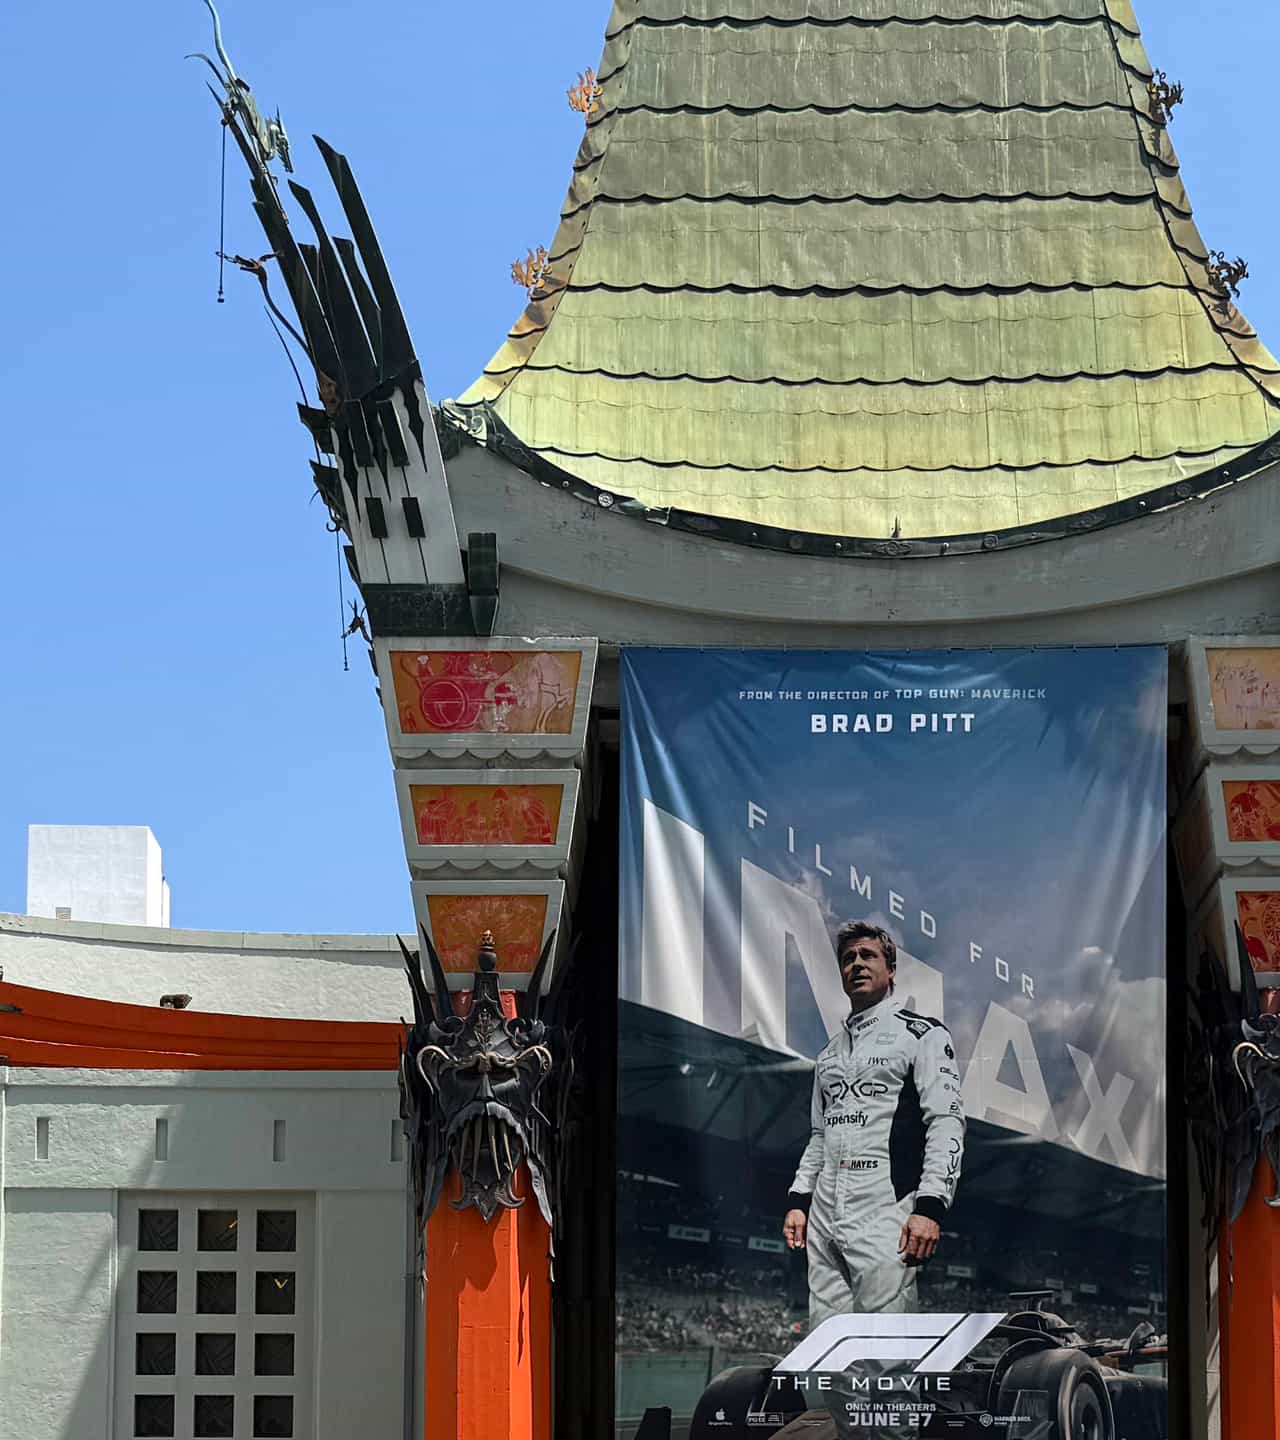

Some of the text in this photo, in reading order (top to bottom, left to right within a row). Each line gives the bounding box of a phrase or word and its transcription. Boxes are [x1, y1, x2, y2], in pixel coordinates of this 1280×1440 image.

[738, 687, 1047, 700] FROM THE DIRECTOR OF TOP GUN: MAVERICK
[810, 712, 976, 733] BRAD PITT
[747, 800, 1035, 999] FILMED FOR
[850, 1159, 879, 1169] HAYES
[772, 1312, 1009, 1374] F1
[771, 1376, 952, 1391] THE MOVIE
[845, 1402, 937, 1412] ONLY IN THEATERS
[848, 1412, 901, 1427] JUNE
[908, 1412, 933, 1427] 27
